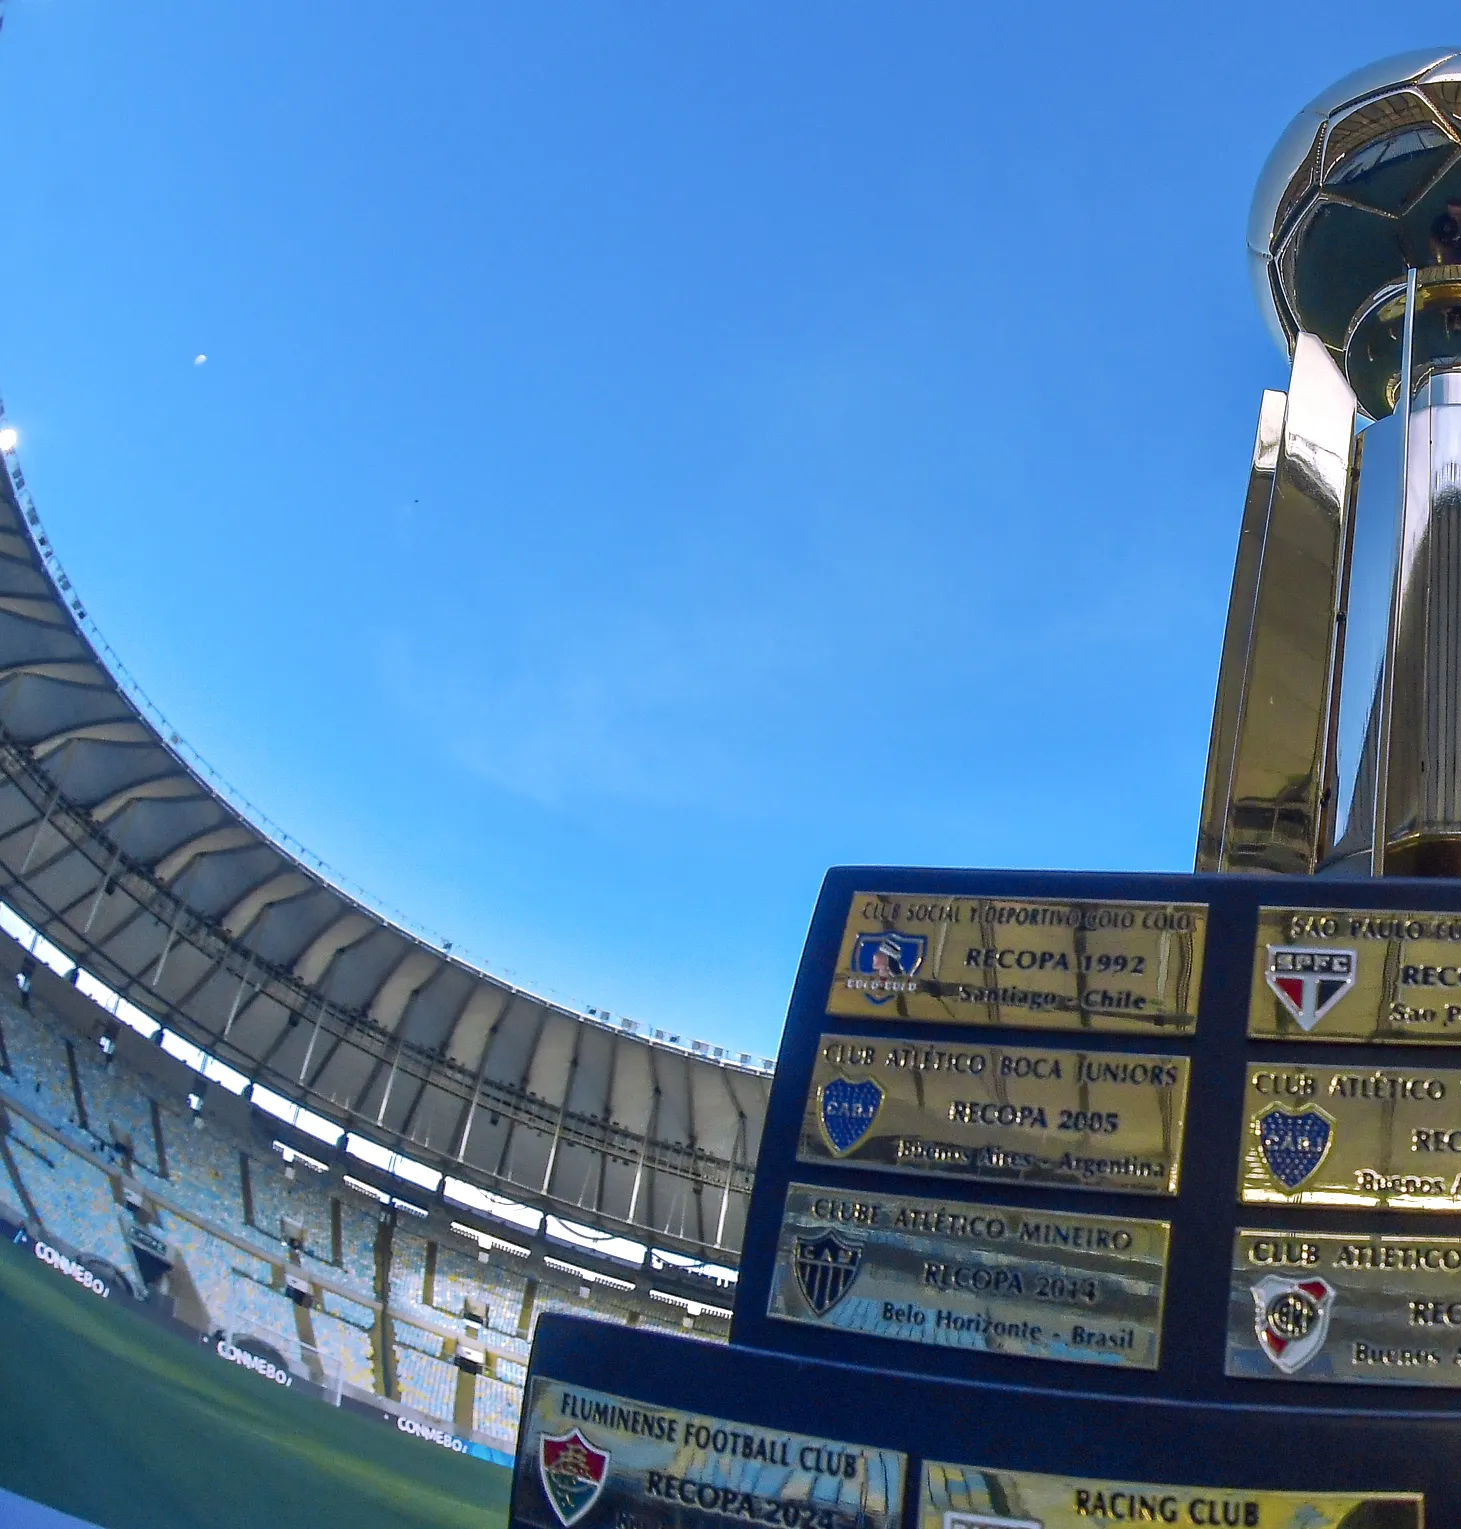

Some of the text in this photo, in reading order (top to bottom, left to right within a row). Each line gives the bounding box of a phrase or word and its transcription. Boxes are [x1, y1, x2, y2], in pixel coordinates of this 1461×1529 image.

[907, 903, 960, 923] SOCIAL
[1350, 918, 1424, 941] PAULO
[964, 949, 1146, 976] RECOPA 1992
[1276, 954, 1349, 972] SPFC
[958, 986, 1057, 1010] Santiago
[1084, 989, 1146, 1010] Chile
[823, 1044, 876, 1065] CLUB
[1000, 1055, 1062, 1079] BOCA
[1077, 1062, 1177, 1086] JUNIORS
[1253, 1071, 1316, 1095] CLUB
[948, 1102, 1118, 1133] RECOPA 2005
[897, 1139, 968, 1163] Buenos
[976, 1147, 1033, 1168] Aires
[1059, 1152, 1165, 1179] Argentina
[1356, 1170, 1444, 1192] Buenos
[811, 1198, 1132, 1250] CLUBE ATLÉTICO MINEIRO
[1249, 1242, 1319, 1266] CLUB
[923, 1261, 1023, 1294] RECOPA
[883, 1302, 925, 1325] Belo
[936, 1309, 1042, 1341] Horizonte
[1072, 1326, 1134, 1349] Brasil
[560, 1392, 857, 1479] FLUMINENSE FOOTBALL CLUB
[648, 1470, 754, 1518] RECOPA
[1074, 1489, 1259, 1527] RACING CLUB
